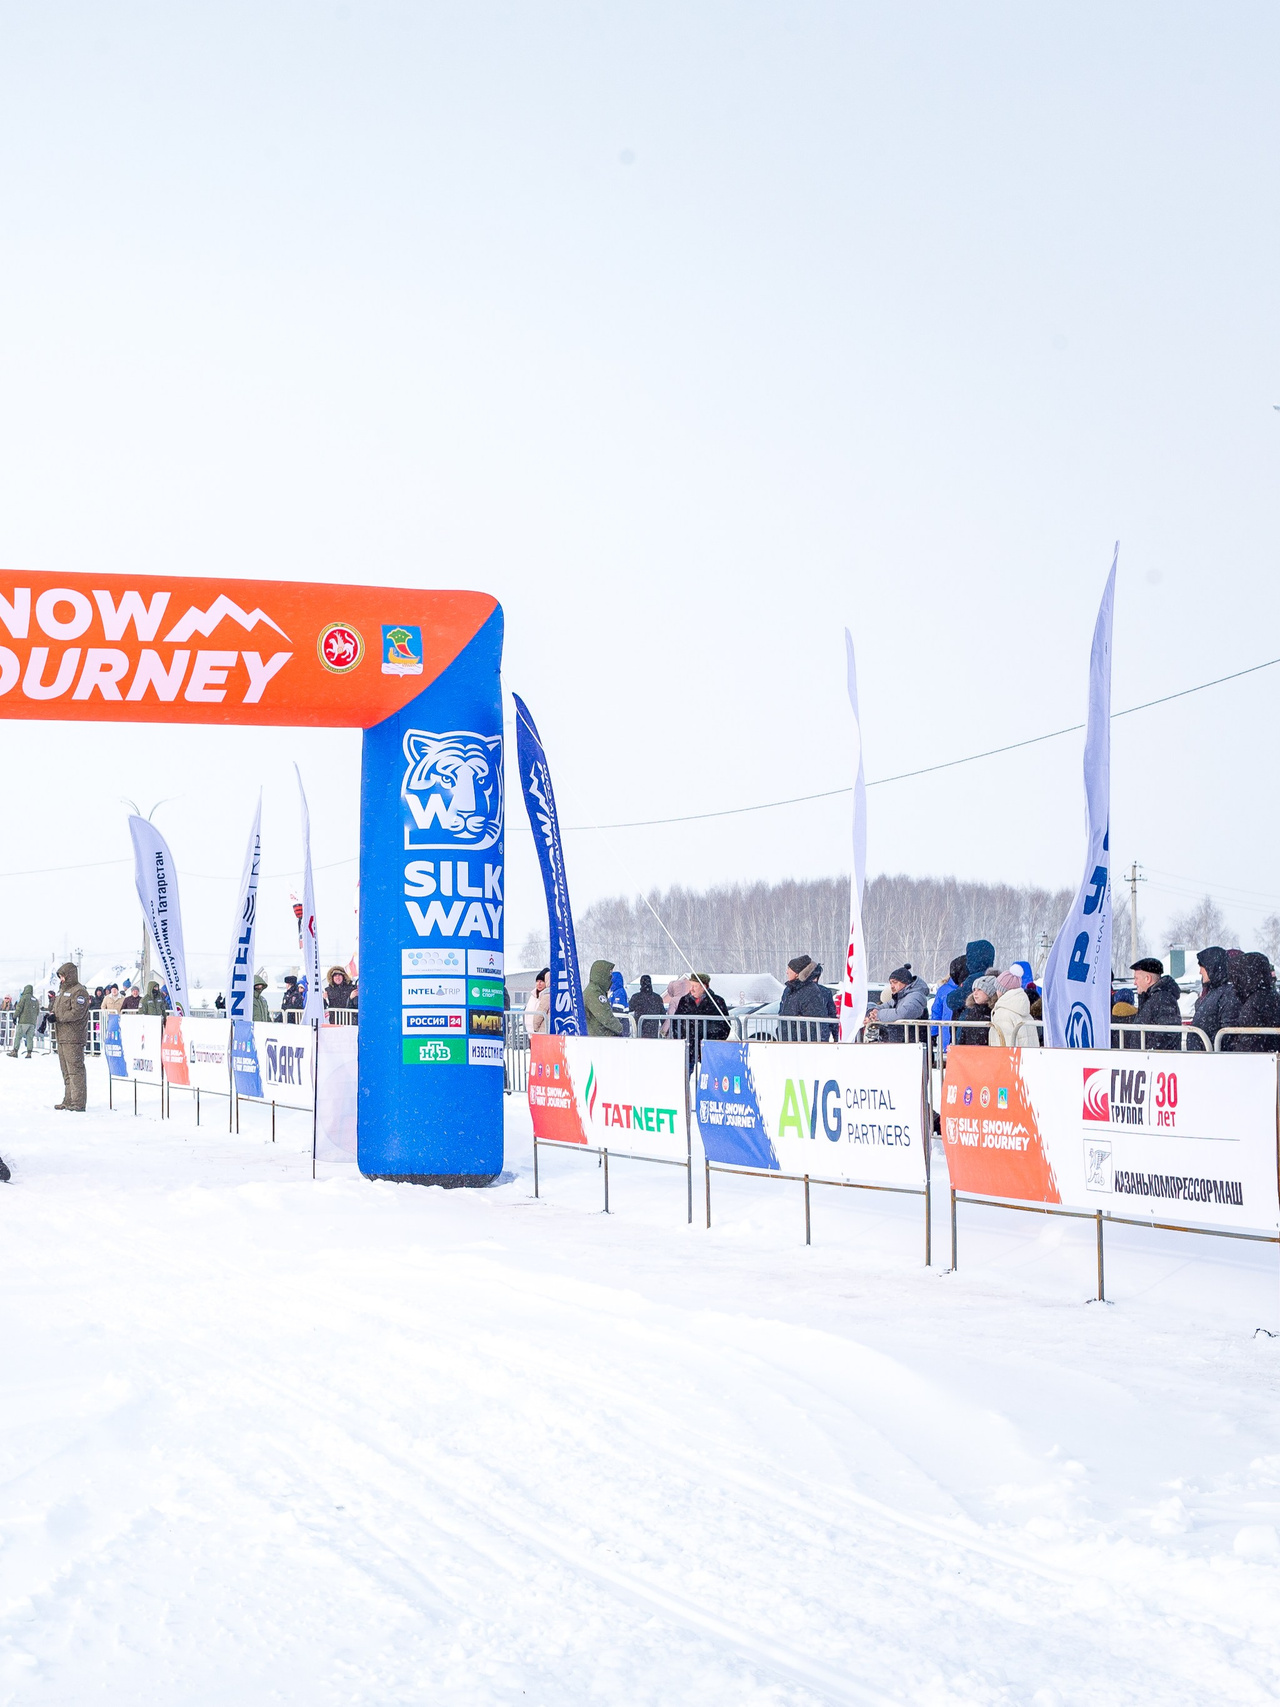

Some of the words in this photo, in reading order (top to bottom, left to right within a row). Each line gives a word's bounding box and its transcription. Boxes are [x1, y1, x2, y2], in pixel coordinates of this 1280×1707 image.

[155, 851, 168, 915] Татарстан
[404, 860, 503, 900] SILK
[405, 900, 503, 940] WAY
[160, 919, 181, 992] Республики
[231, 927, 252, 1019] NTEL
[444, 987, 460, 995] TRIP
[410, 1017, 445, 1025] РОССИЯ
[266, 1043, 305, 1085] NART
[422, 1043, 450, 1058] НТВ
[1111, 1069, 1147, 1105] ГМС
[1156, 1072, 1178, 1108] 30
[602, 1102, 677, 1134] TATNEFT
[778, 1078, 842, 1142] AVG
[846, 1088, 896, 1110] CAPITAL
[959, 1118, 979, 1133] SILK
[982, 1120, 1014, 1135] SNOW
[1111, 1105, 1144, 1126] ГРУППА
[1157, 1110, 1176, 1127] лет
[848, 1123, 911, 1147] PARTNERS
[960, 1132, 979, 1147] WAY
[982, 1135, 1030, 1151] JOURNEY
[1115, 1170, 1243, 1206] КАЗАНЬКОМПРЕССОРМАШ
